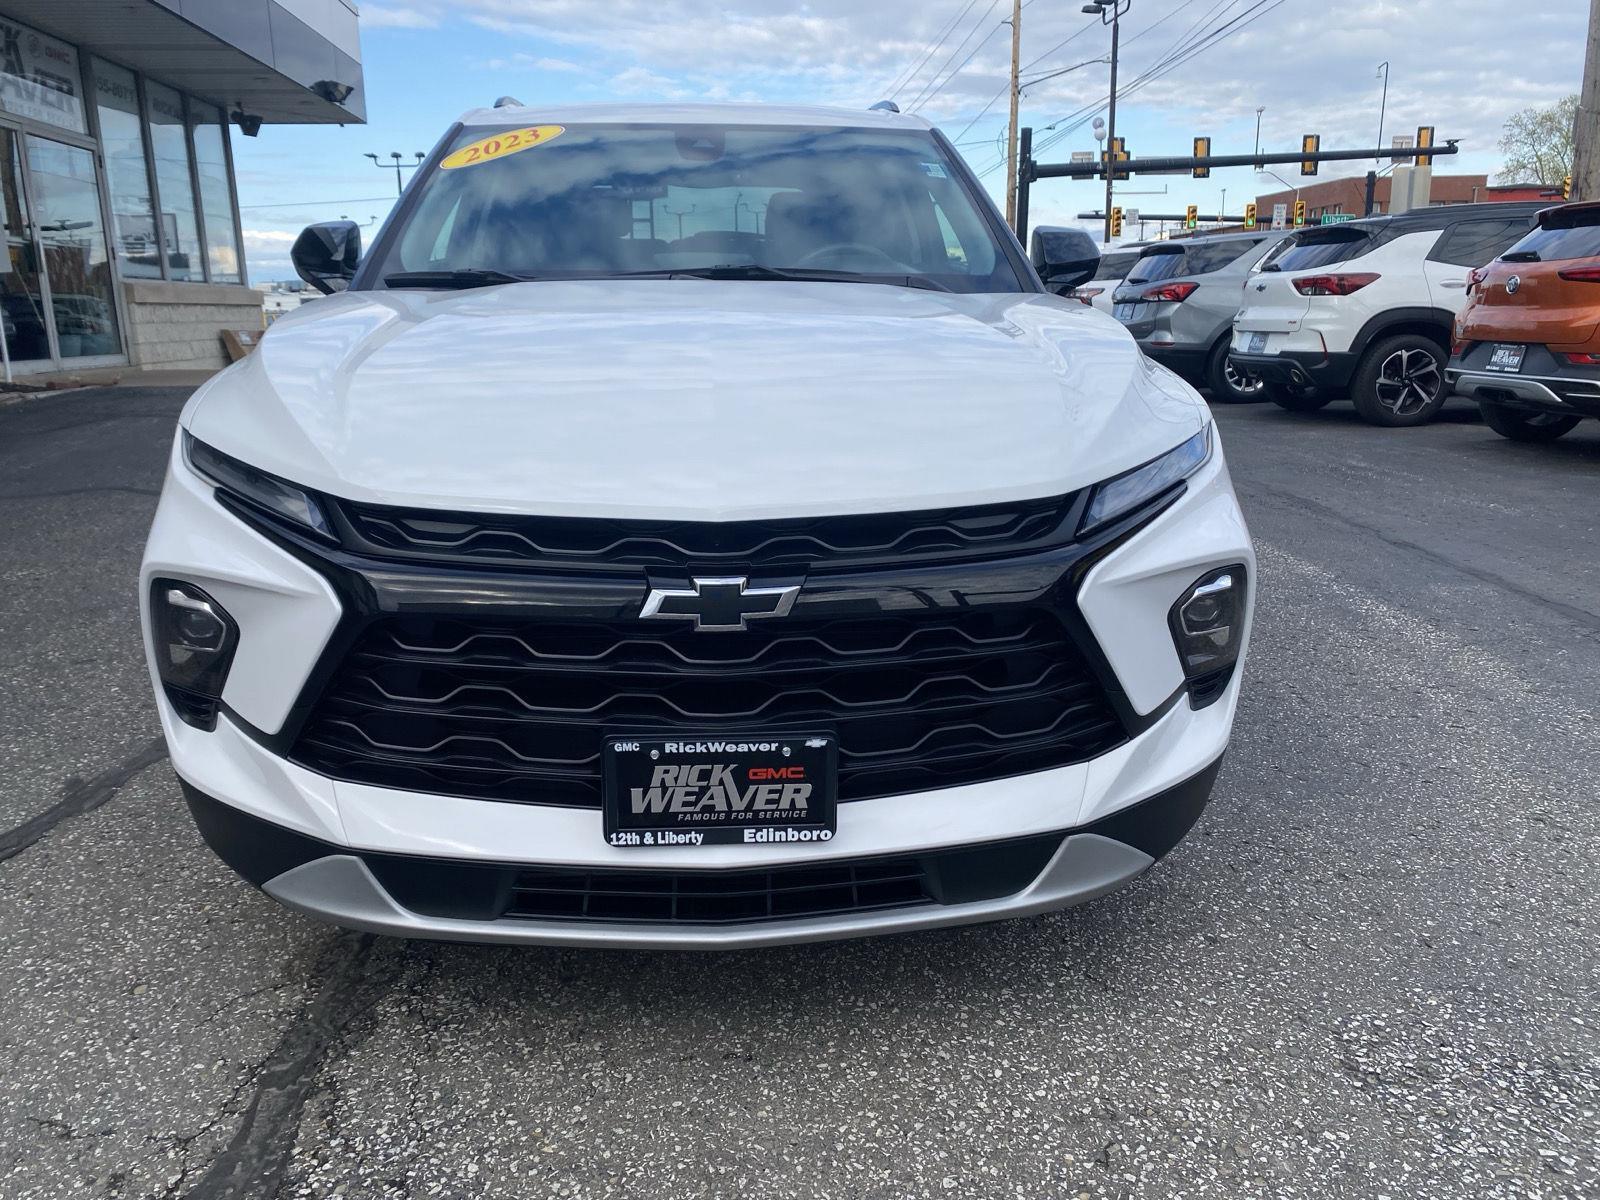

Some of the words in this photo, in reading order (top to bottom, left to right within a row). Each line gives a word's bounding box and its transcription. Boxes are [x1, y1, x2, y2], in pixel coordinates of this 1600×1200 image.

[463, 129, 541, 164] 2023
[614, 742, 640, 752] GMC
[664, 741, 779, 753] RickWeaver
[650, 763, 738, 788] RICK
[748, 767, 805, 780] GMC
[630, 783, 813, 814] WEAVER
[677, 812, 726, 822] FAMOUS
[731, 811, 753, 820] FOR
[758, 810, 808, 819] SERVICE
[610, 832, 640, 845] 12th
[643, 832, 655, 845] &
[657, 831, 704, 845] Liberty
[743, 828, 833, 843] Edinboro
